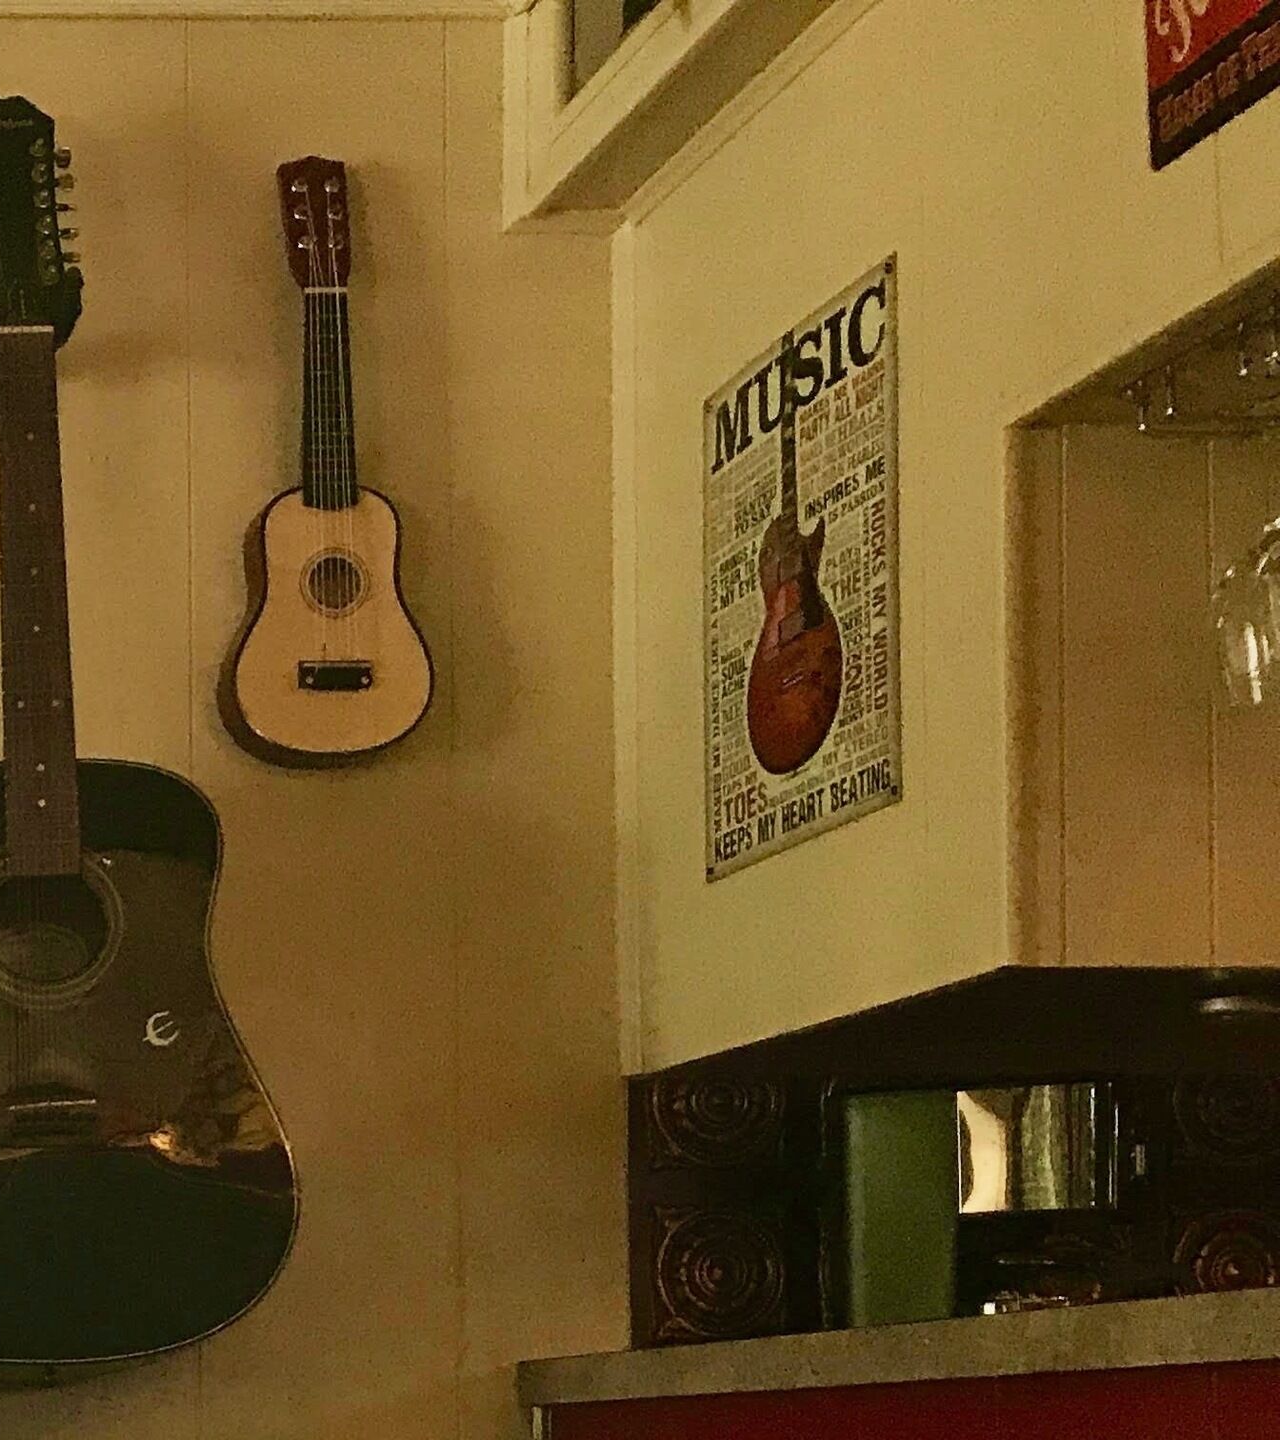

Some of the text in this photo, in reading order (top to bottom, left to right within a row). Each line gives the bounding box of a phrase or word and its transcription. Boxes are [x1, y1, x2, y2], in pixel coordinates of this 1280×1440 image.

[711, 278, 886, 476] MUSIC
[799, 406, 831, 449] PARTY
[804, 469, 859, 526] INSPIRES
[865, 453, 885, 487] ME
[719, 572, 756, 612] MY EYE
[830, 566, 861, 608] THE
[872, 580, 886, 623] MY
[873, 625, 888, 713] WORLD
[714, 819, 753, 865] KEEPS
[757, 808, 776, 846] MY
[781, 786, 823, 836] HEART
[830, 755, 891, 814] BEATING
[723, 778, 768, 832] TOES
